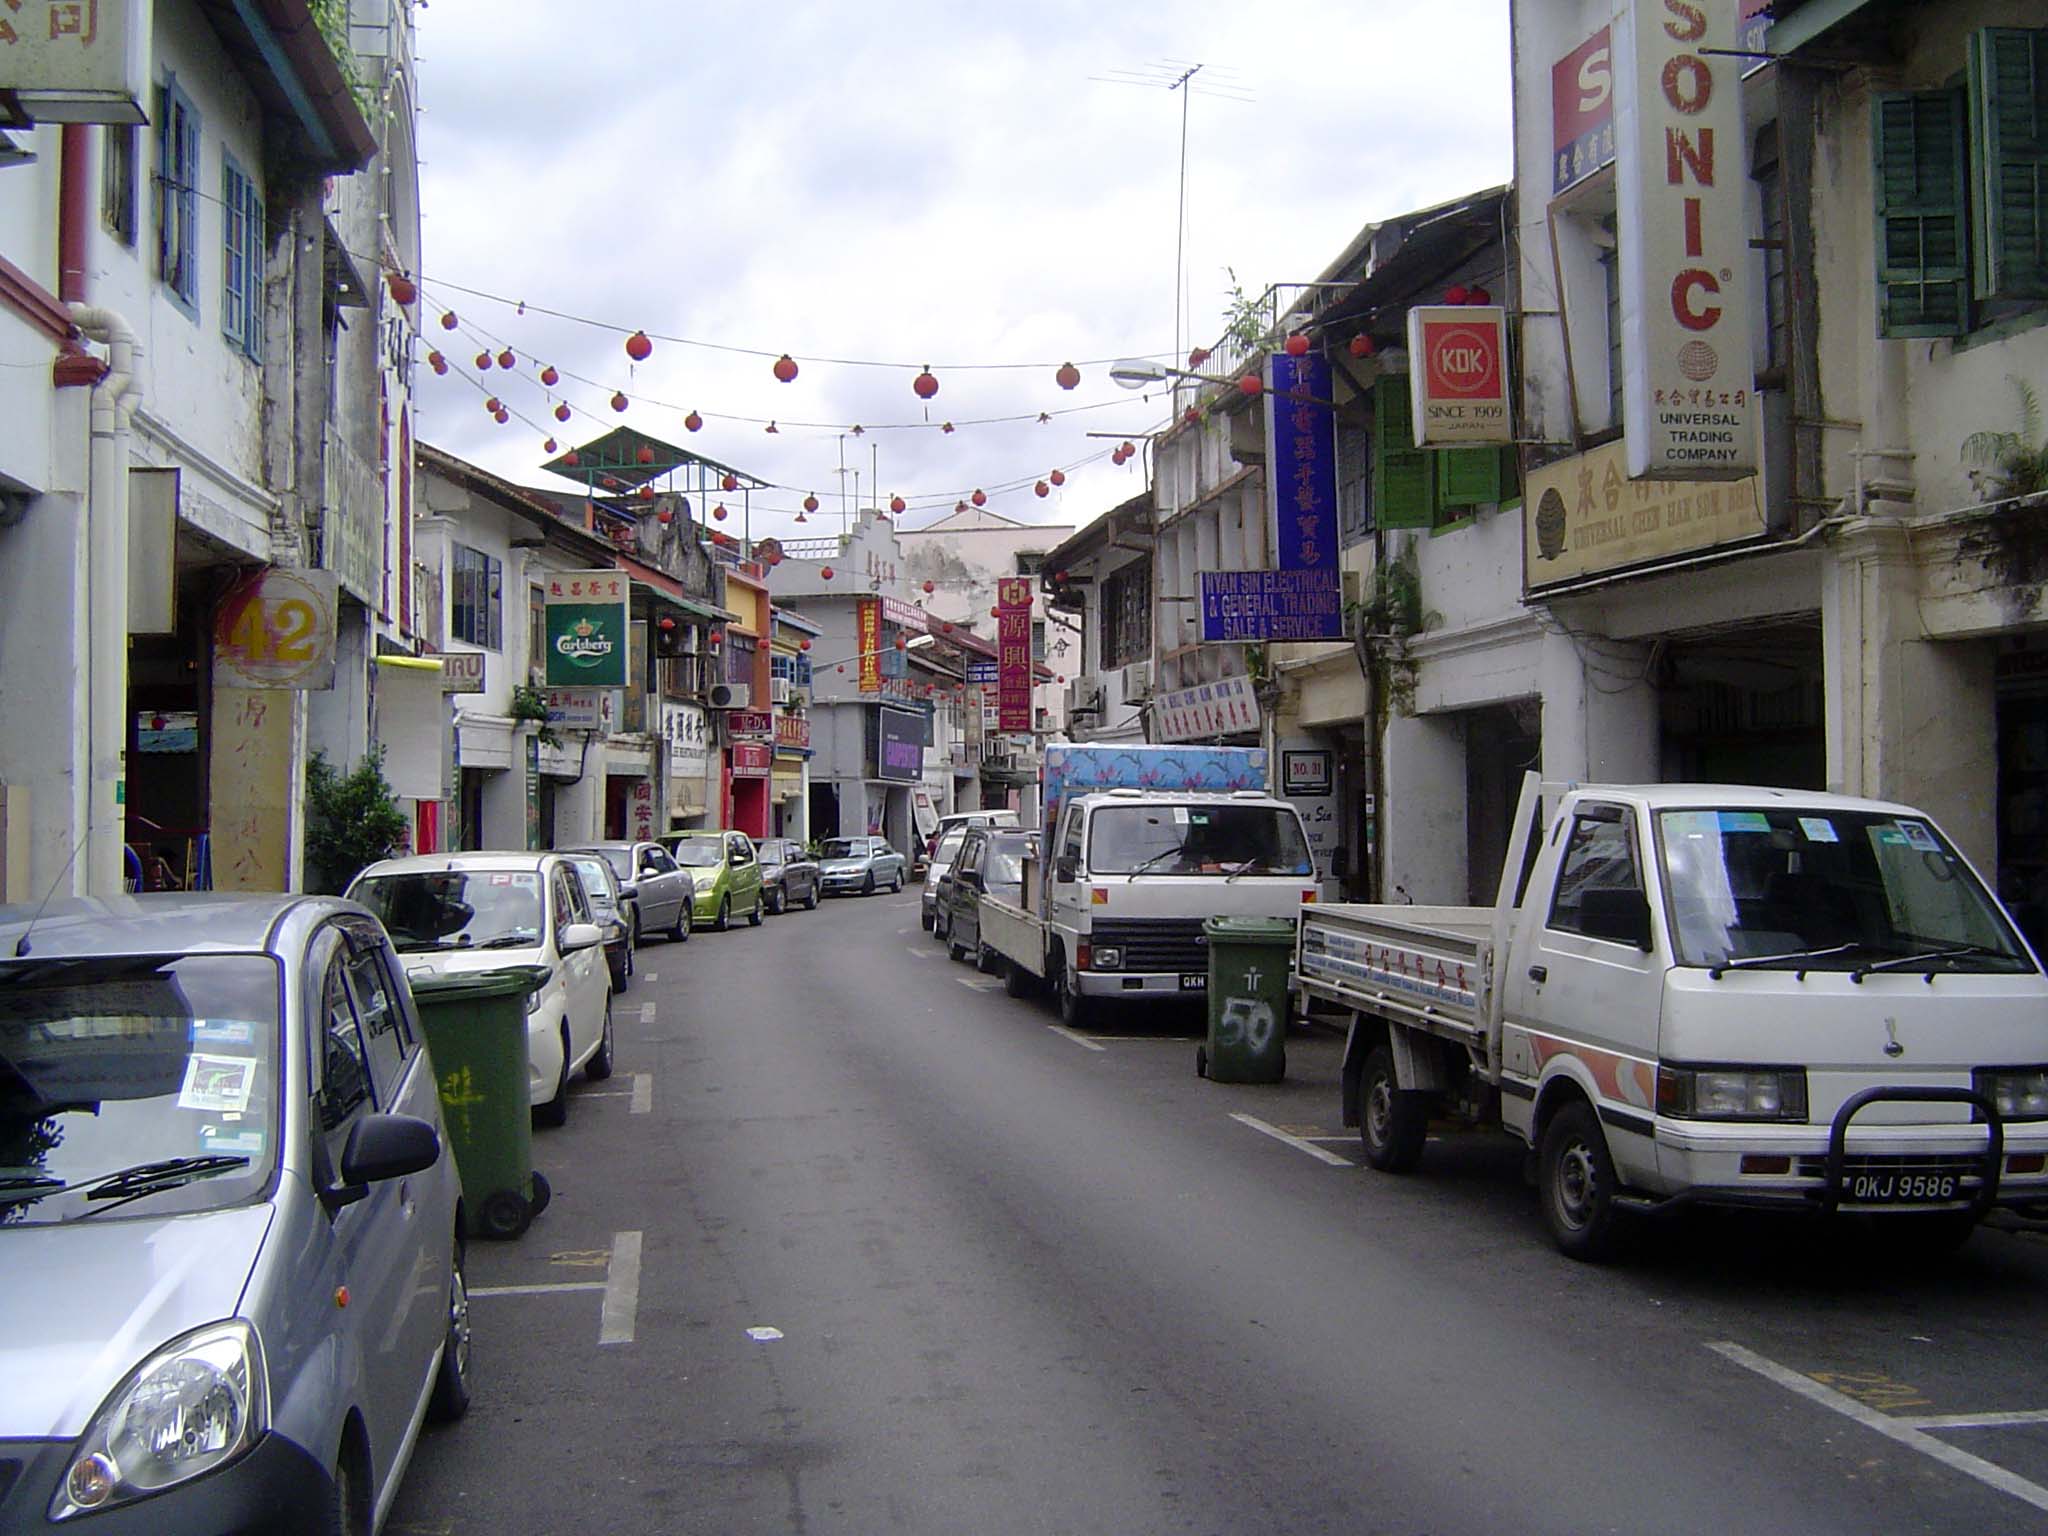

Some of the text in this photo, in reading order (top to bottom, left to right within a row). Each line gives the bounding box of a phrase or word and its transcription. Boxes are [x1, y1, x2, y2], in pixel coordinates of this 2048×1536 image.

[1442, 347, 1484, 374] KDK
[1428, 405, 1503, 418] SINCE 1909
[1660, 413, 1740, 426] UNIVERSAL
[1448, 422, 1485, 430] JAPAN
[1669, 431, 1734, 443] TRADING
[1666, 448, 1738, 461] COMPANY
[1222, 593, 1278, 616] GENERAL
[1282, 592, 1336, 614] TRADING
[230, 598, 316, 662] 42
[1223, 617, 1256, 640] SALE
[1271, 616, 1324, 639] SERVICE
[557, 634, 612, 655] Carlsberg
[1221, 997, 1275, 1052] 50
[1855, 1176, 1955, 1197] QKJ 9586
